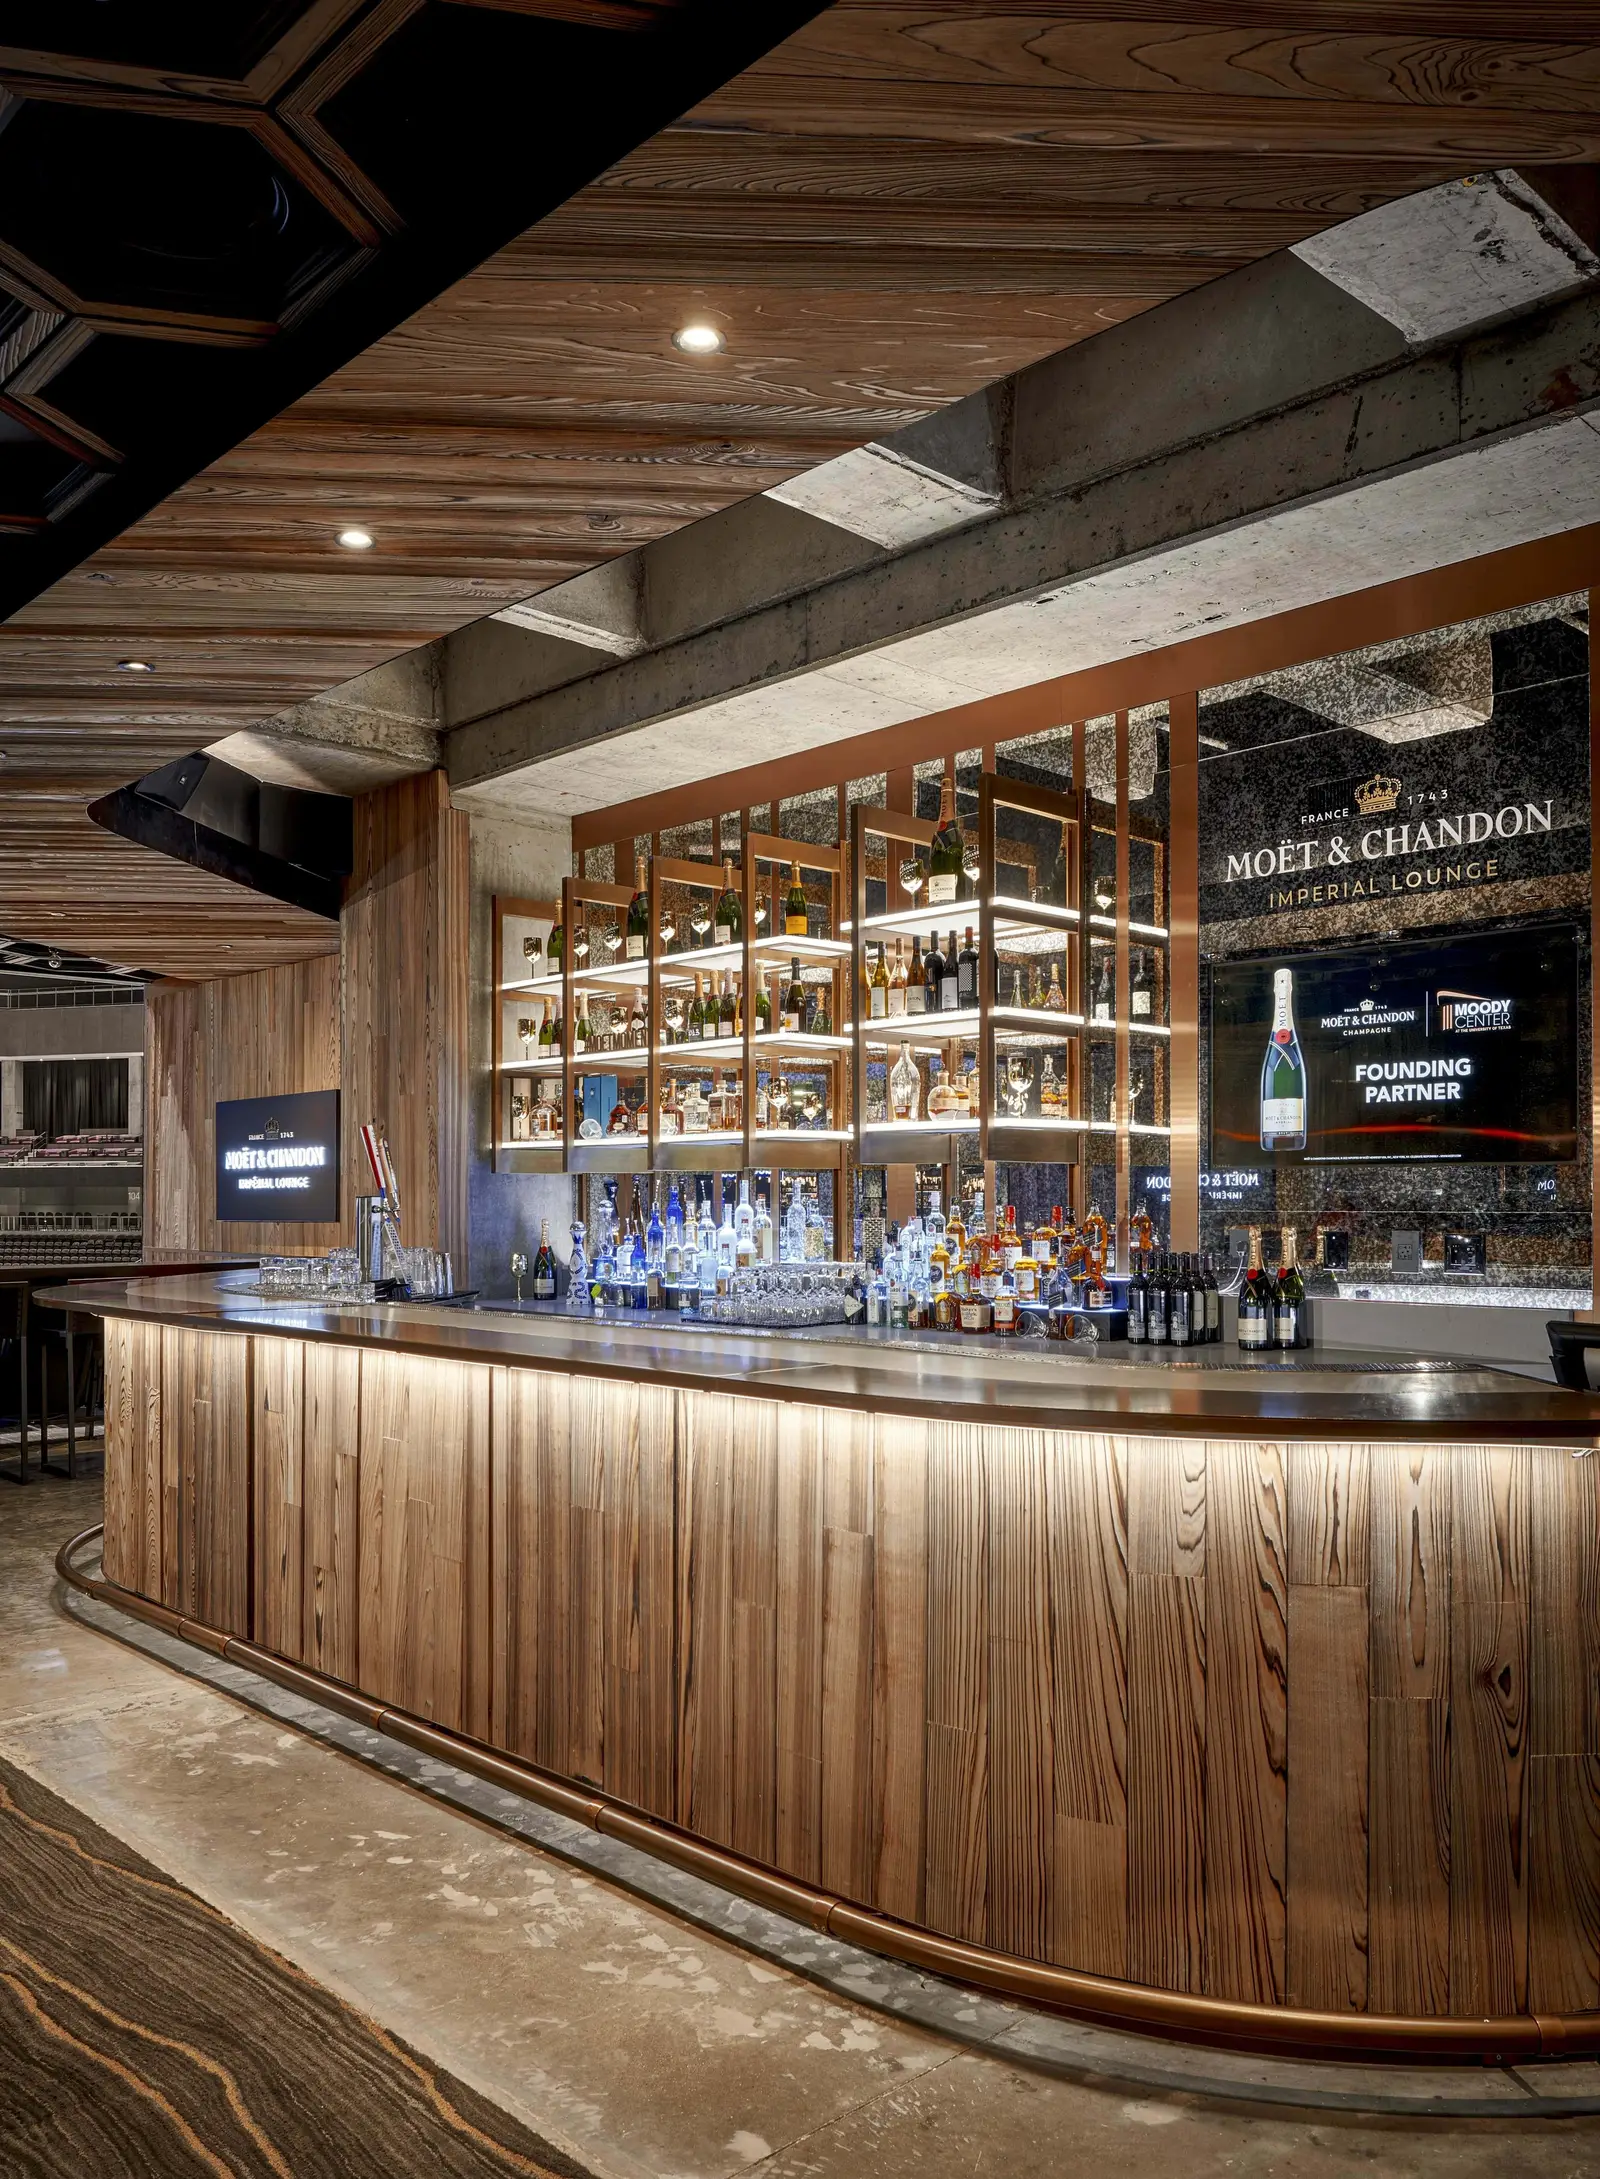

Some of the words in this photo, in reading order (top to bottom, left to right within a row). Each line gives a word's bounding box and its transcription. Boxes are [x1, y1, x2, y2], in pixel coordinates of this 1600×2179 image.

[1301, 807, 1349, 825] FRANCE
[1407, 789, 1449, 805] 1743
[1225, 838, 1319, 883] MOËT
[1328, 836, 1353, 866] &
[1361, 800, 1554, 861] CHANDON
[1269, 877, 1380, 908] IMPERIAL
[1392, 859, 1499, 890] LOUNGE
[1455, 1000, 1511, 1016] MOODY
[1352, 1016, 1360, 1026] &
[1362, 1011, 1416, 1025] CHANDON
[1455, 1013, 1511, 1029] CENTER
[1343, 1027, 1392, 1036] CHAMPAGNE
[1355, 1058, 1471, 1082] FOUNDING
[1365, 1082, 1461, 1104] PARTNER
[225, 1147, 257, 1170] MOËT
[257, 1150, 267, 1169] &
[267, 1146, 326, 1168] CHANDON
[275, 1177, 310, 1188] LOUNGE
[128, 1191, 140, 1201] 104
